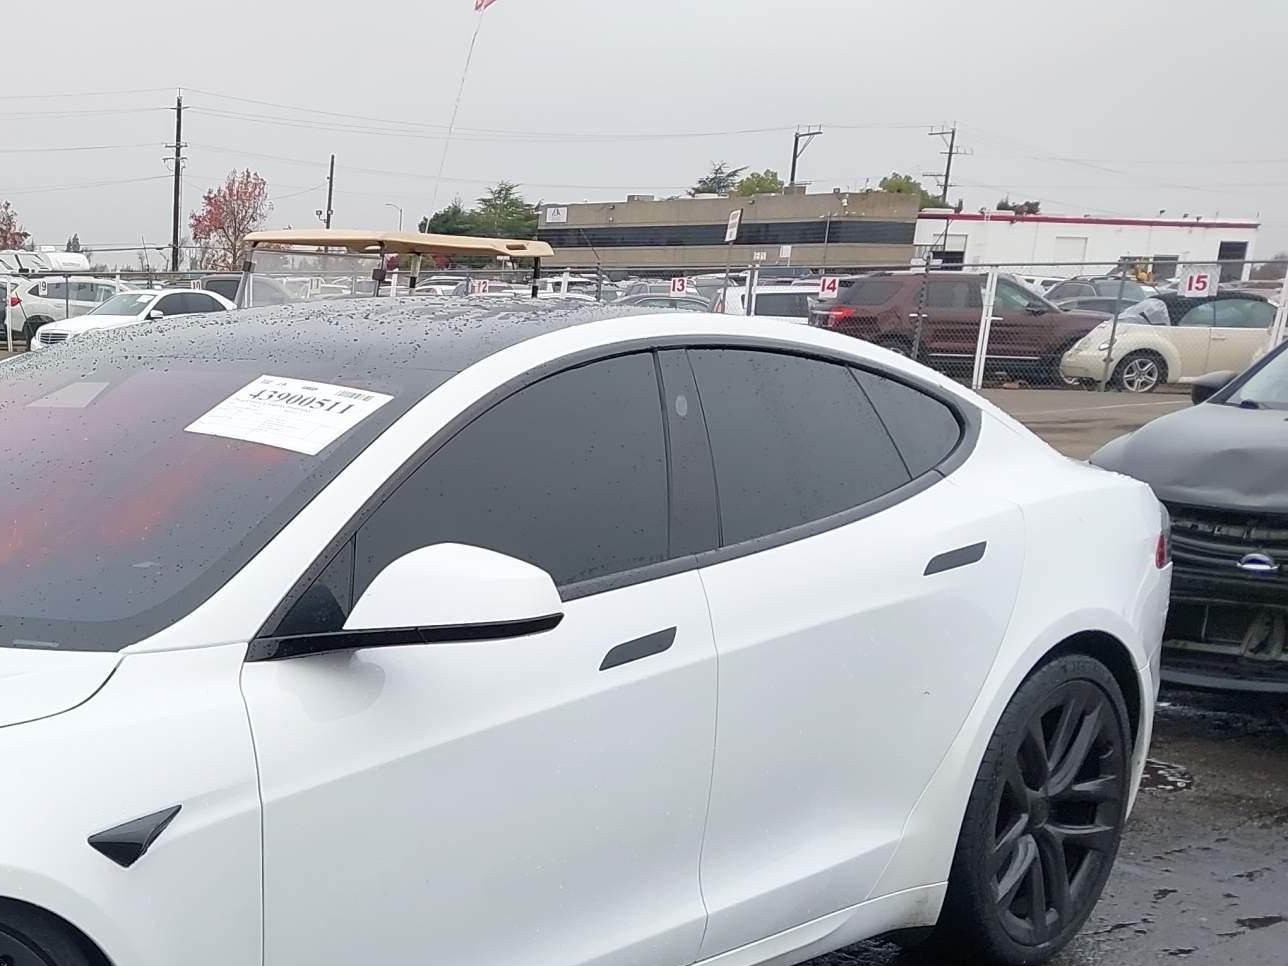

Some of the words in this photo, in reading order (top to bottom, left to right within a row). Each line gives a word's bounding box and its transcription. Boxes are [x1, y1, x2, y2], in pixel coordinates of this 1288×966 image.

[672, 279, 685, 292] 13
[822, 278, 837, 292] 14
[1187, 275, 1208, 291] 15
[249, 389, 355, 415] 43900511
